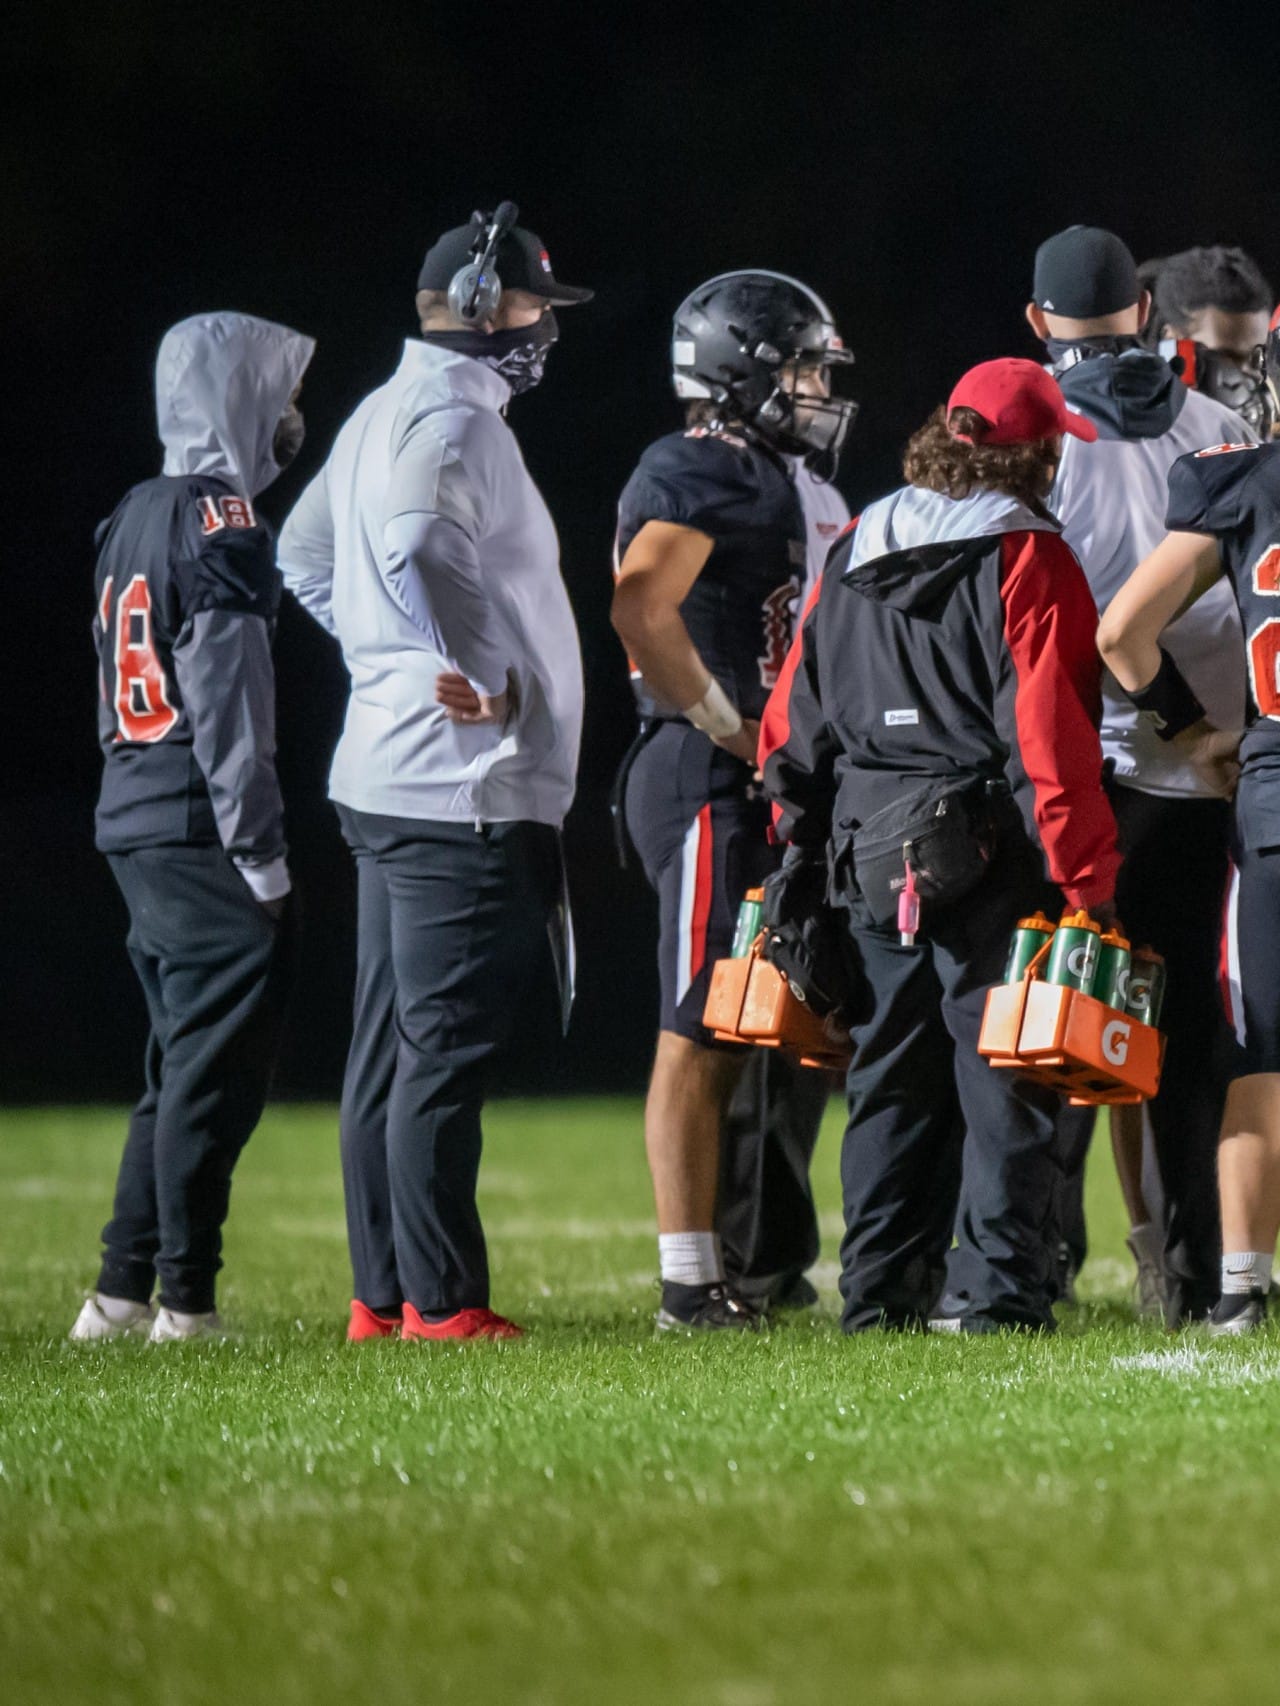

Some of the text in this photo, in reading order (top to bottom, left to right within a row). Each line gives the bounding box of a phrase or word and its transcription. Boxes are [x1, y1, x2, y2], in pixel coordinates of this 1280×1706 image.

[196, 495, 257, 536] 18
[1067, 947, 1096, 979] G
[1127, 977, 1152, 1010] G
[1101, 1019, 1131, 1066] G
